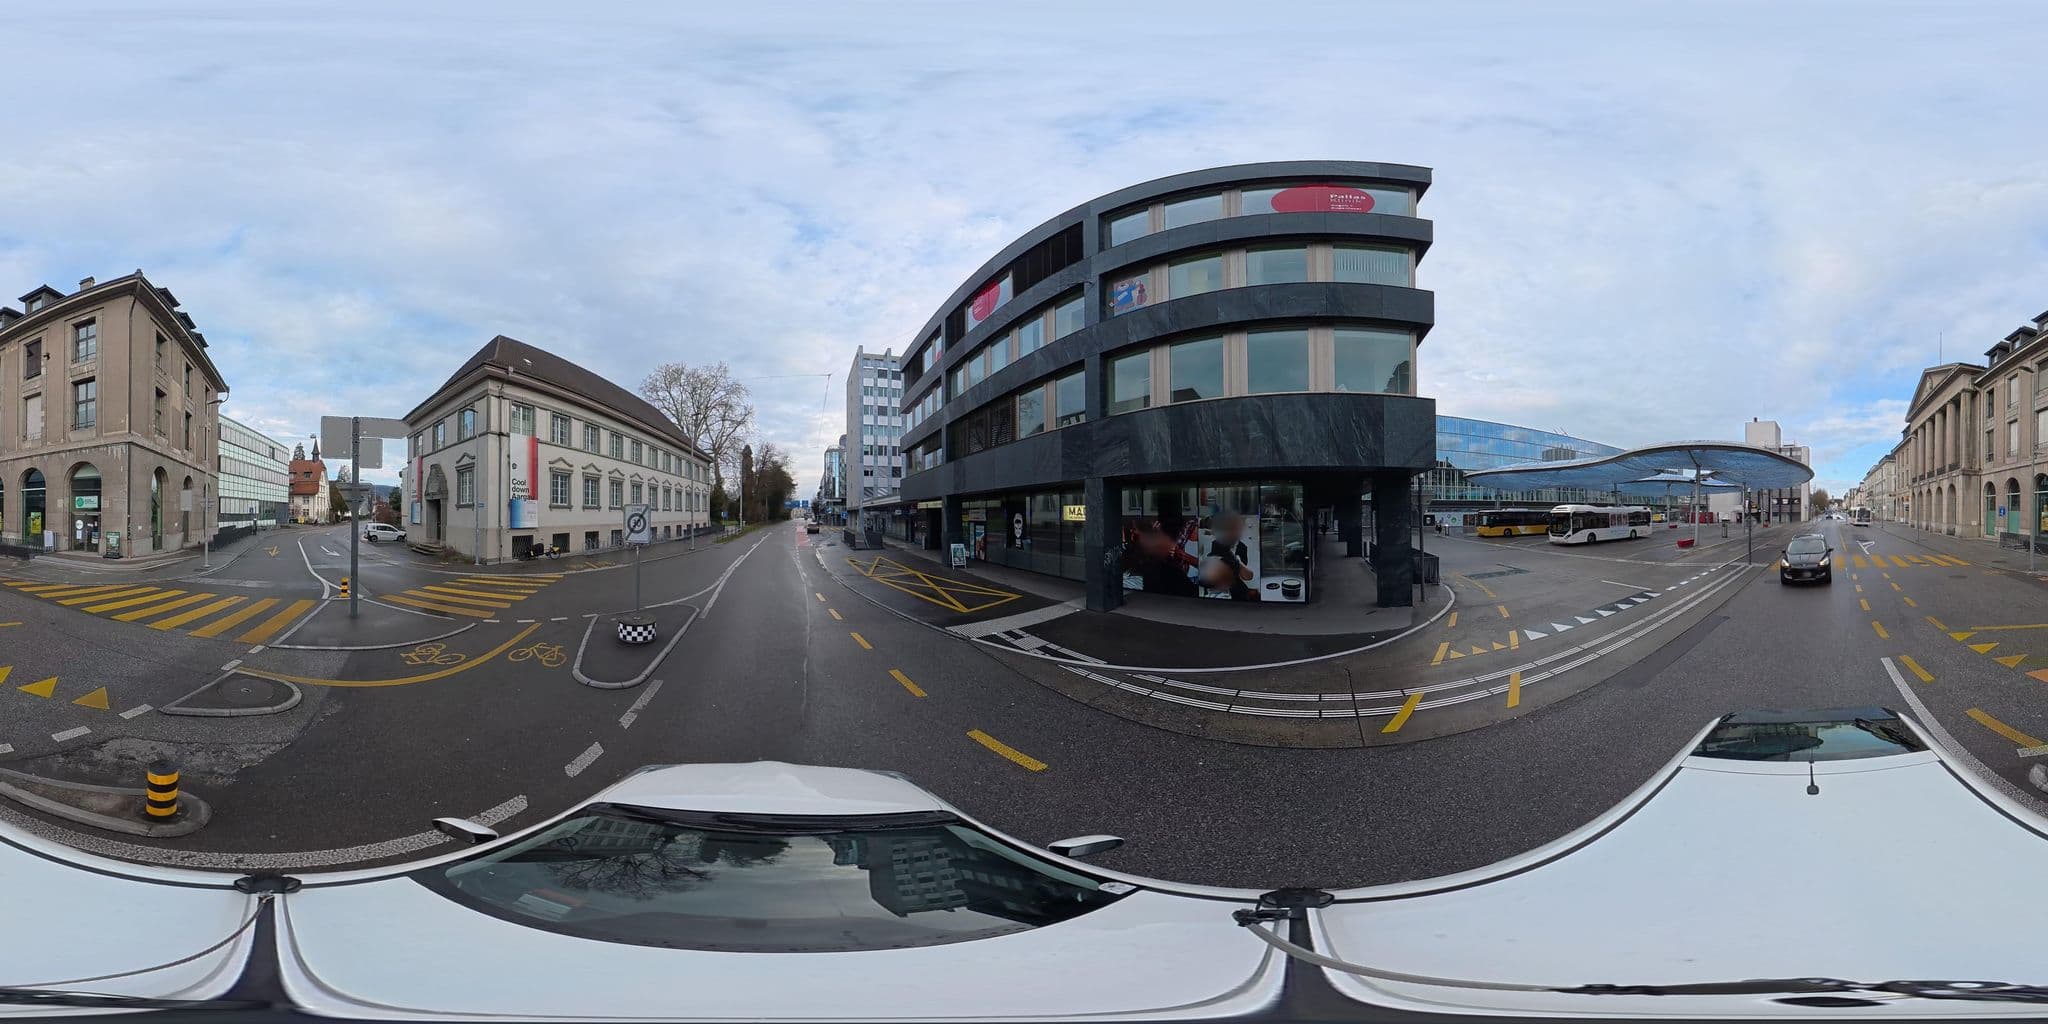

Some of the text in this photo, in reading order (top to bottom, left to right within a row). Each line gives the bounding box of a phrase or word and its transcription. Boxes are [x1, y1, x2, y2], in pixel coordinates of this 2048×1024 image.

[512, 478, 527, 486] Cool
[512, 493, 535, 501] Aargau
[1068, 507, 1086, 516] MA
